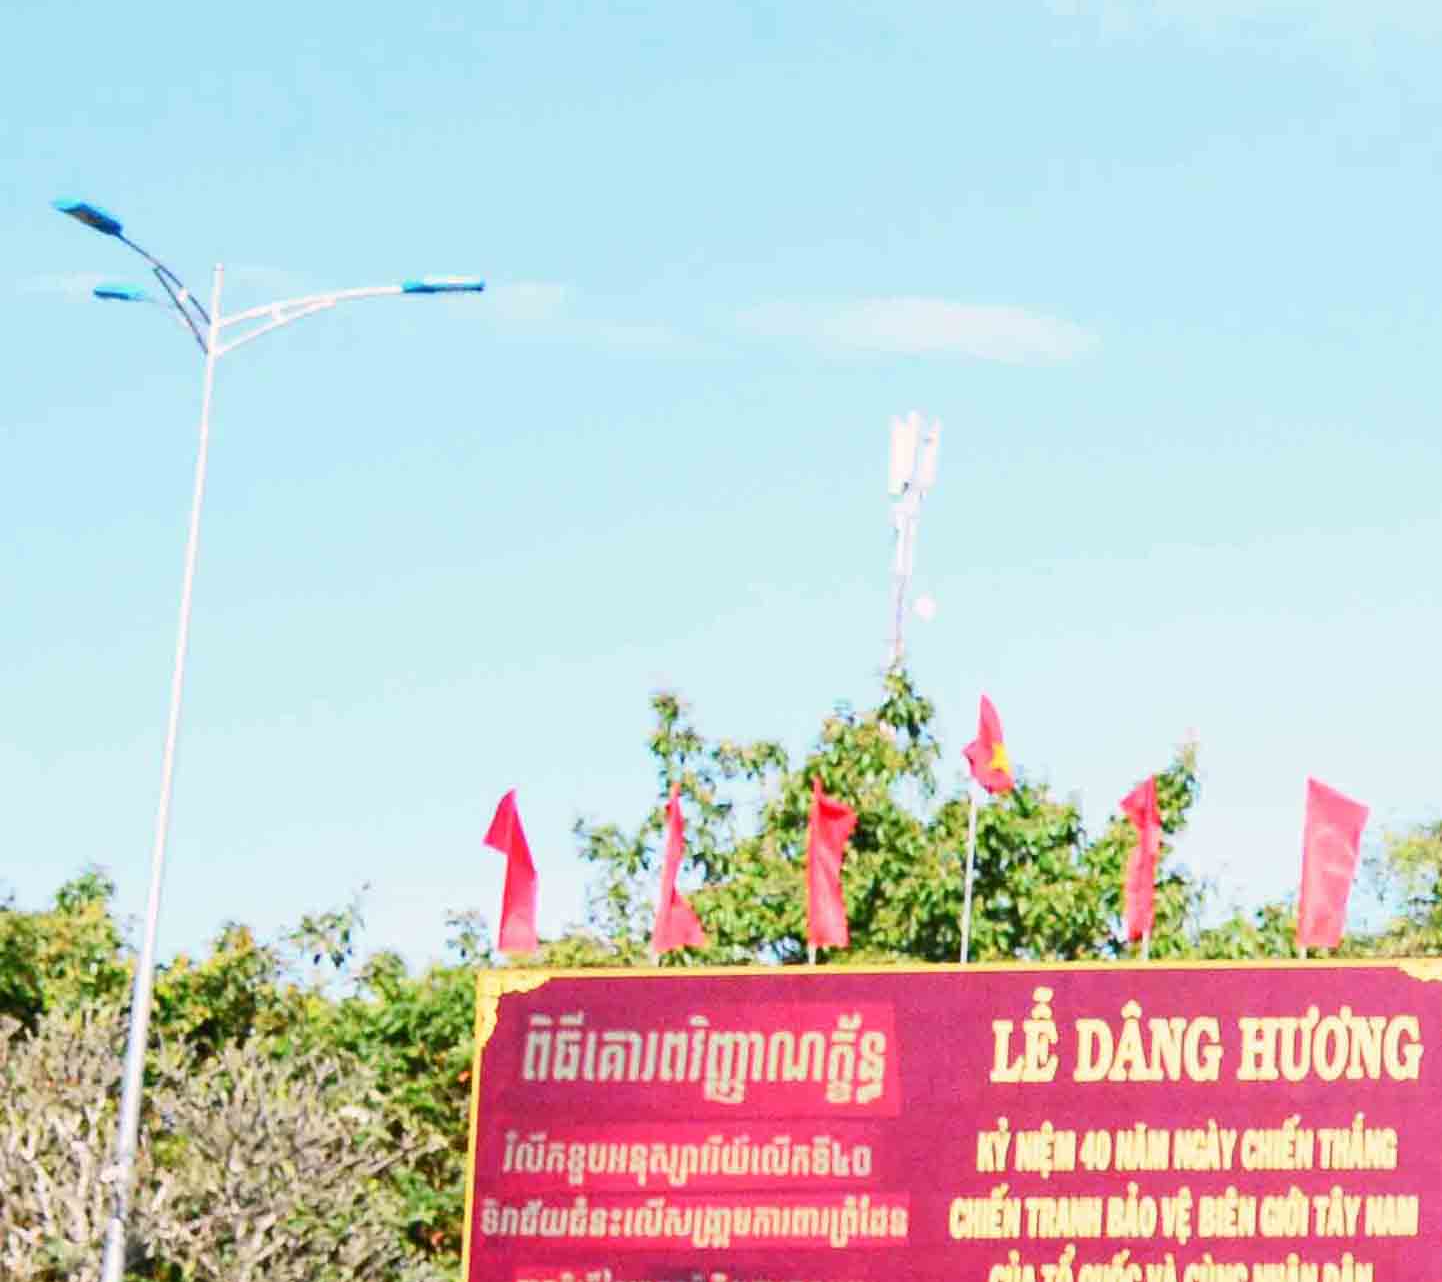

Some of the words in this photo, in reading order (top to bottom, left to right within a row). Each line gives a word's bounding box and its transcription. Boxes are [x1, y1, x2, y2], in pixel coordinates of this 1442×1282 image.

[990, 987, 1060, 1084] LỄ
[1074, 1001, 1225, 1083] DÂNG
[1237, 1006, 1425, 1083] HƯƠNG
[1015, 1121, 1078, 1180] NIỆM
[1080, 1130, 1113, 1172] 40
[1115, 1123, 1171, 1172] NĂM
[1174, 1120, 1239, 1172] NGÀY
[1241, 1115, 1316, 1172] CHIẾN
[1317, 1113, 1399, 1171] THẮNG
[950, 1183, 1023, 1241] CHIẾN
[1025, 1198, 1104, 1239] TRANH
[1107, 1182, 1159, 1239] BẢO
[1161, 1187, 1194, 1246] VỆ
[1198, 1186, 1258, 1239] BIÊN
[1313, 1186, 1363, 1238] TÂY
[1365, 1195, 1420, 1238] NAM
